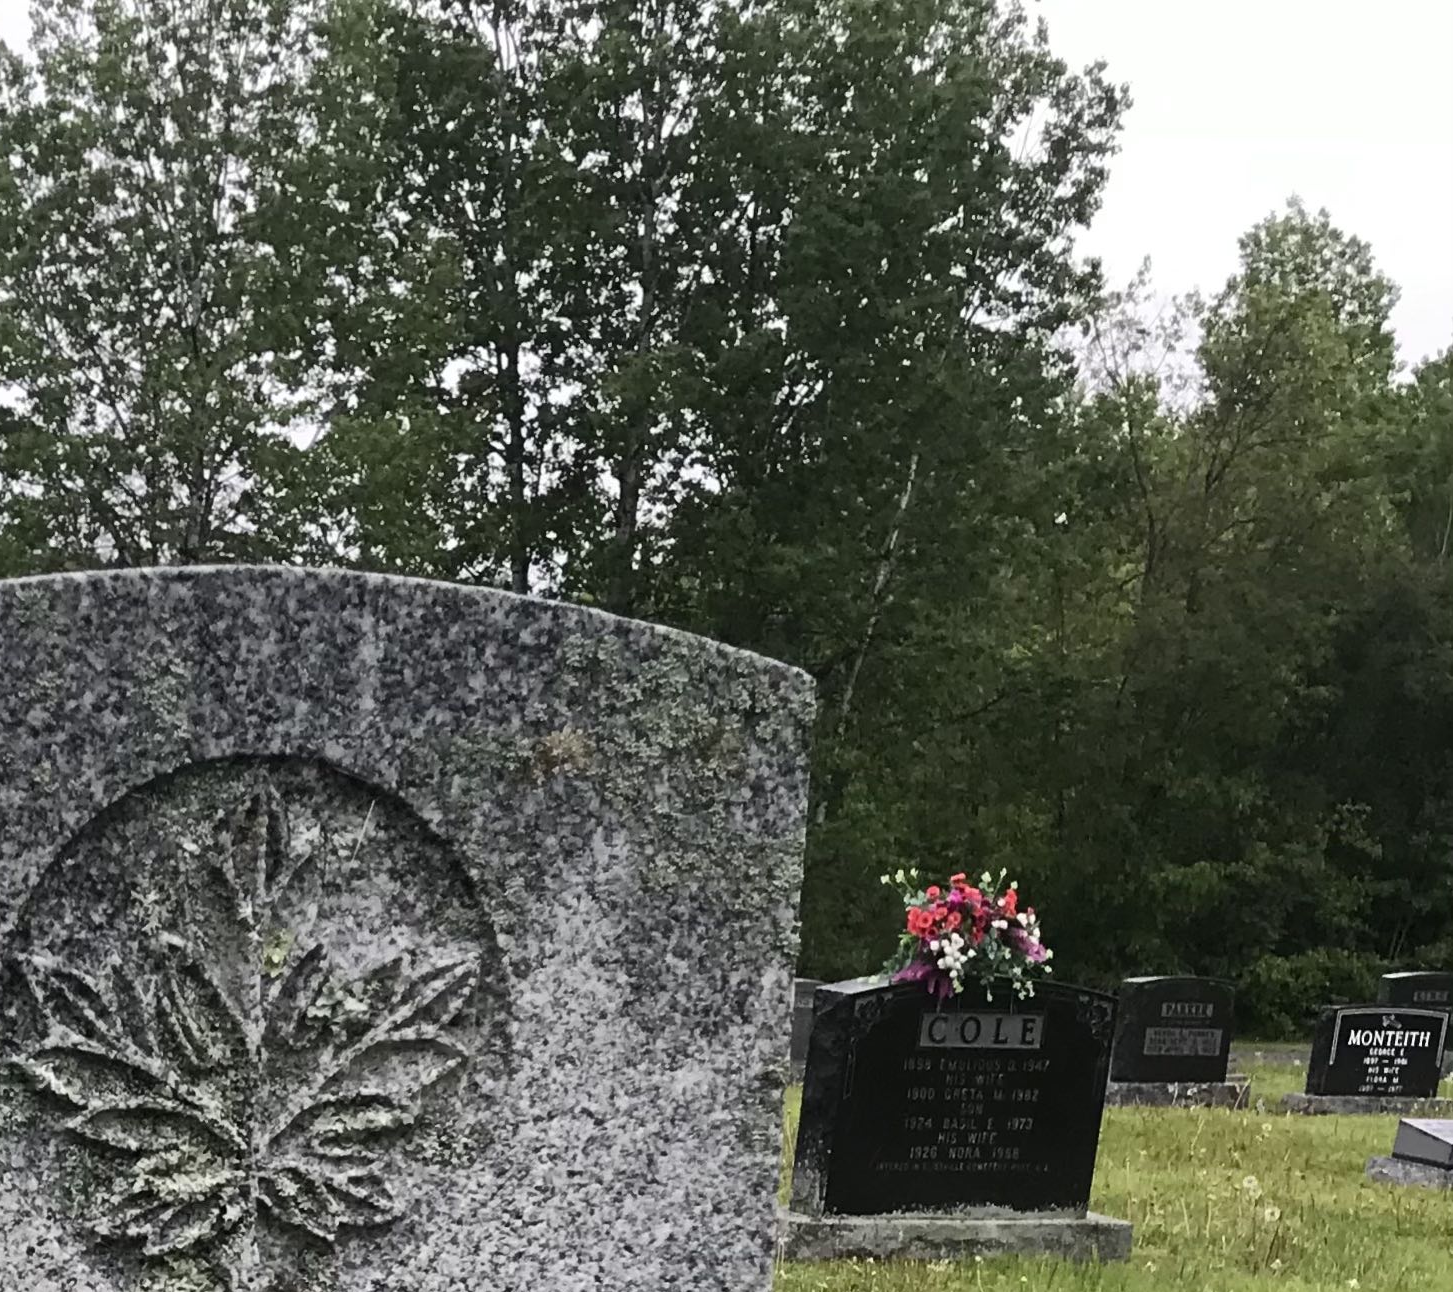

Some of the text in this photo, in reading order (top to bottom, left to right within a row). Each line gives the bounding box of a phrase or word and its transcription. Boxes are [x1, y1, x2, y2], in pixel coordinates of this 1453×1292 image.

[928, 1016, 1037, 1045] COLE
[1347, 1029, 1431, 1047] MONTEITH
[938, 1131, 998, 1145] HIS WIFE
